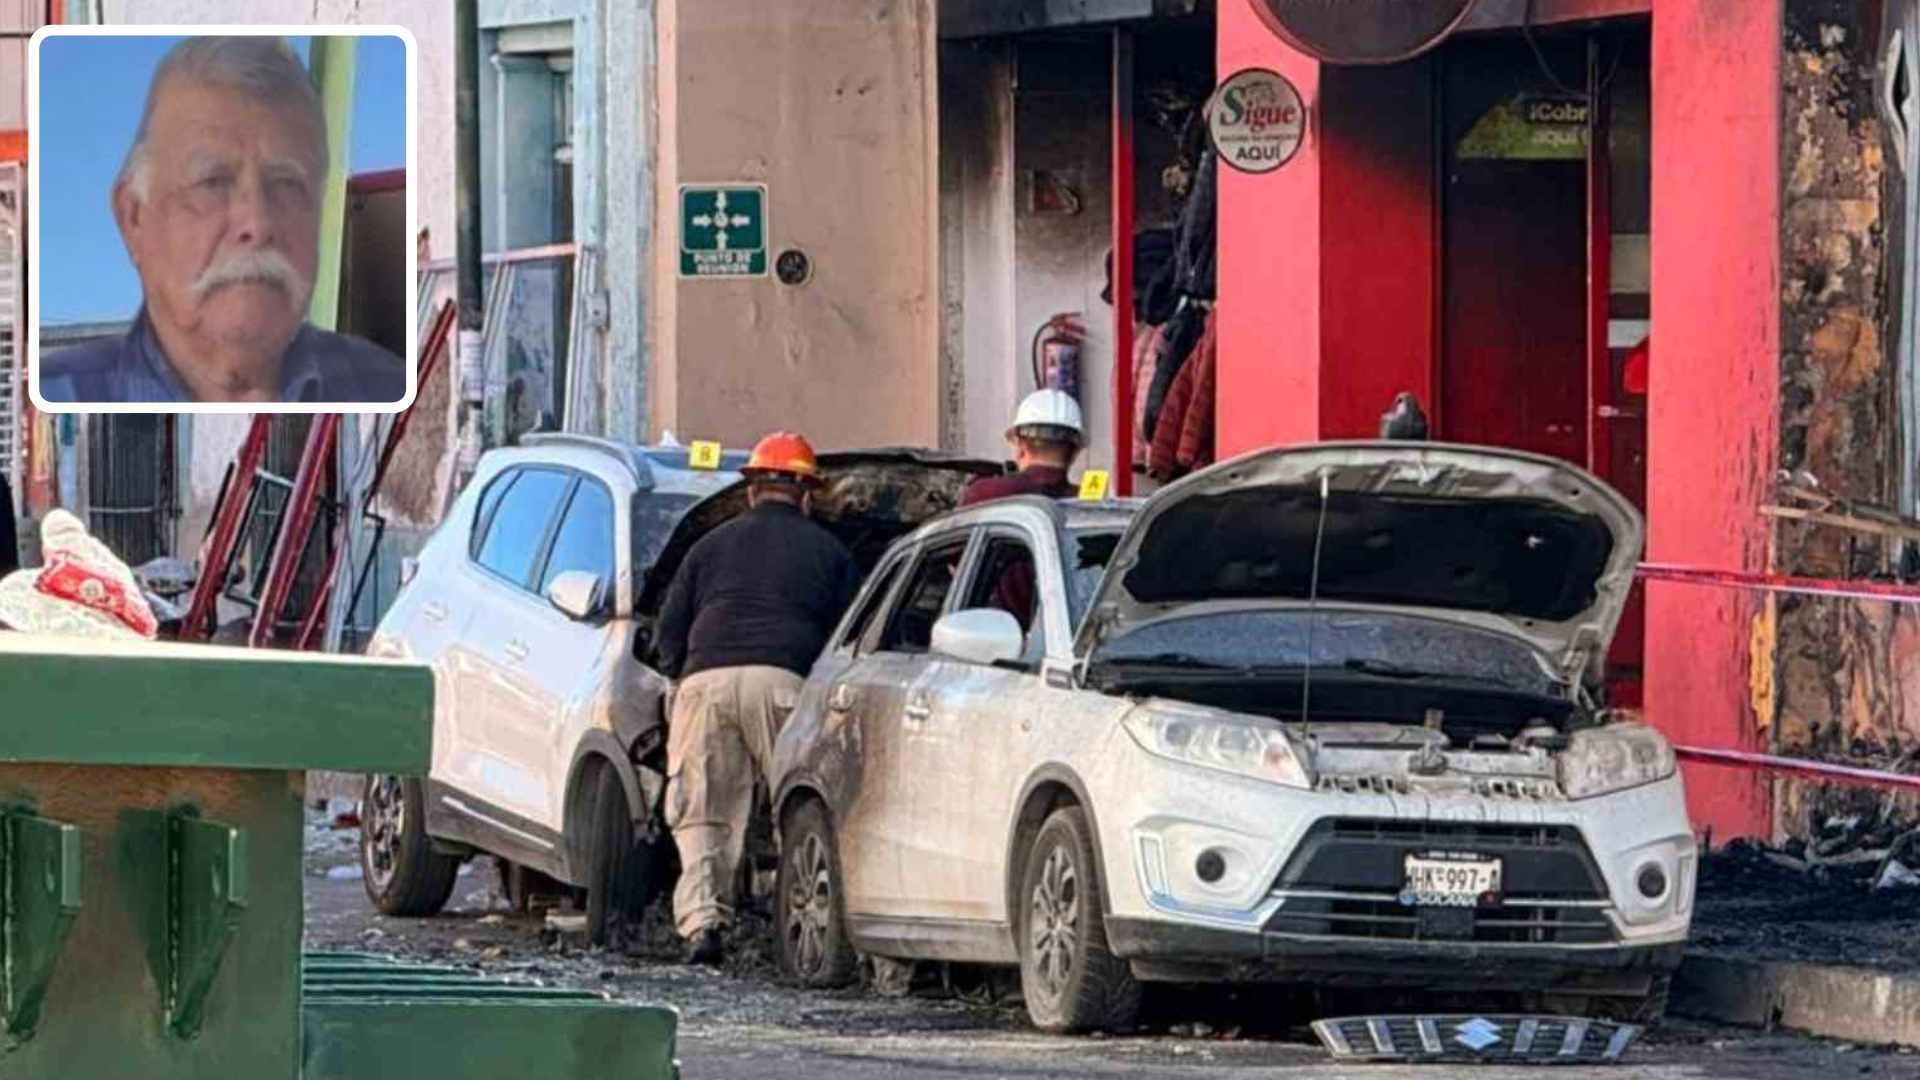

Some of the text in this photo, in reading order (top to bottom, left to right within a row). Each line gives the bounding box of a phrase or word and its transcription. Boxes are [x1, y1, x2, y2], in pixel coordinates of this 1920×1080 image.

[1220, 85, 1296, 133] Sigue
[1236, 144, 1281, 160] AQUÍ
[693, 250, 752, 263] PUNTO DE
[1088, 474, 1100, 489] A
